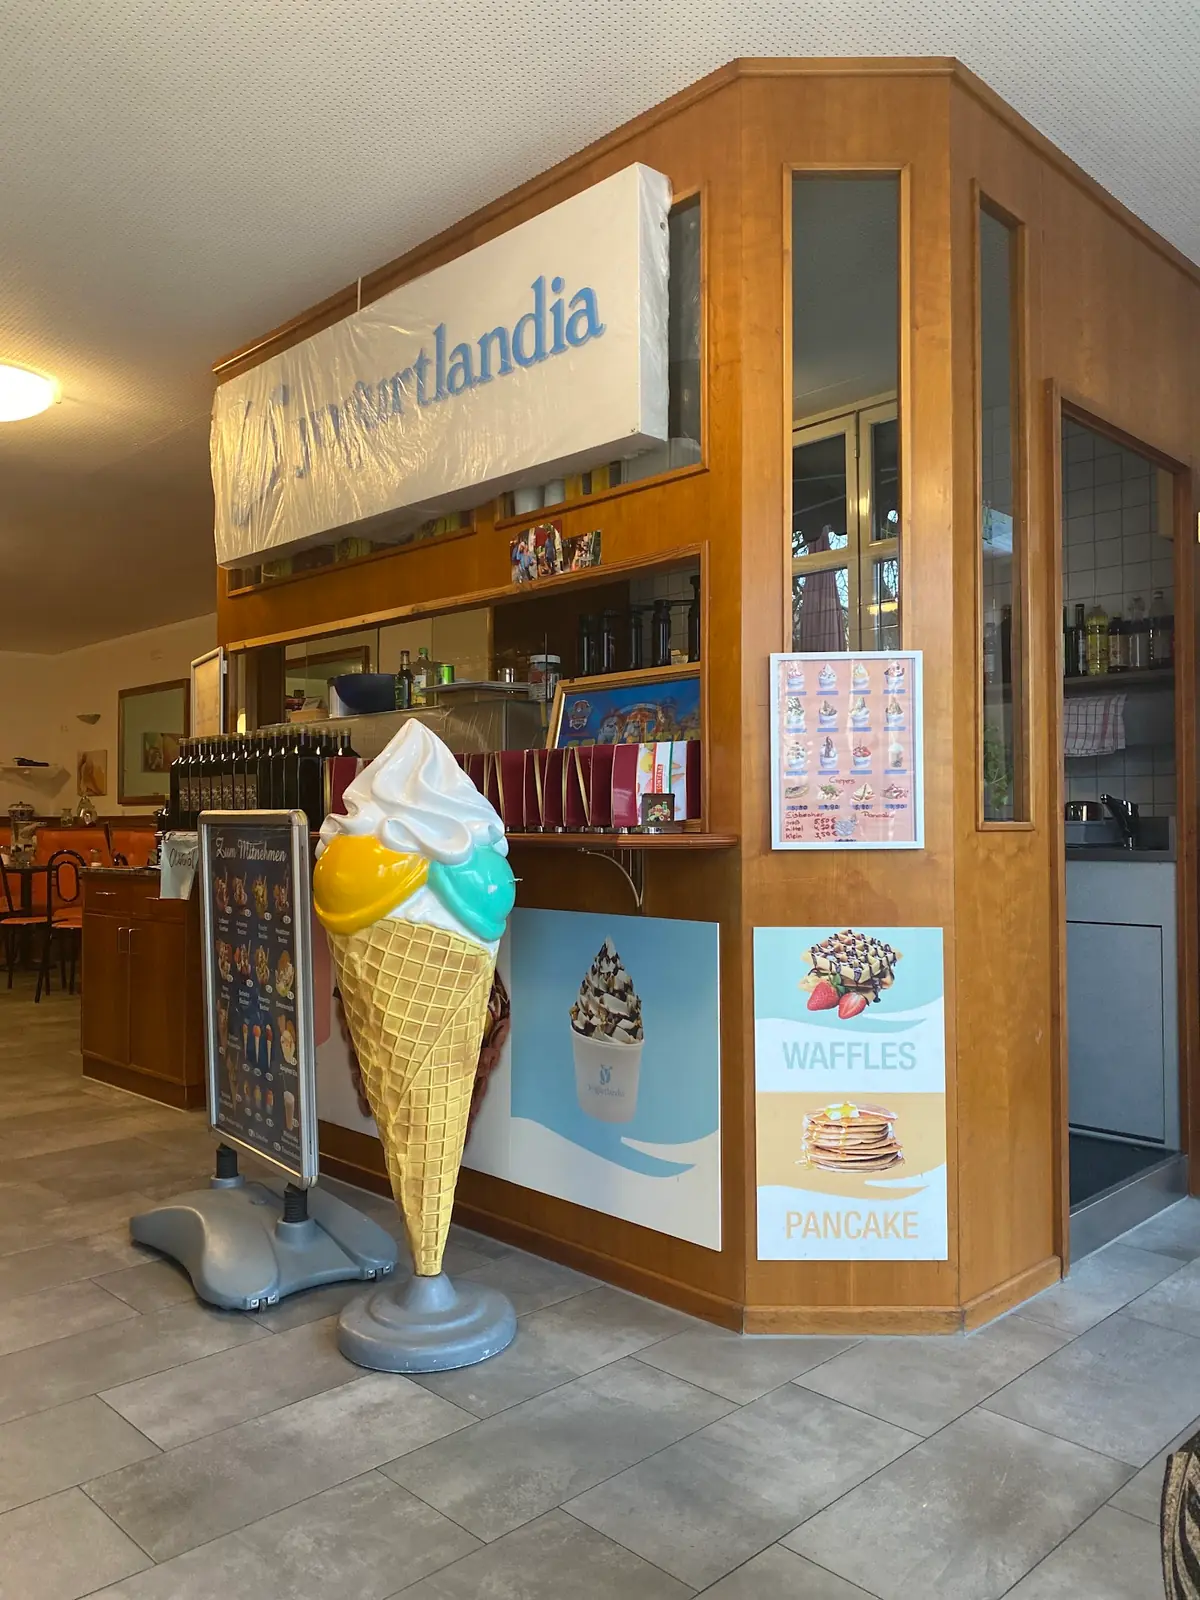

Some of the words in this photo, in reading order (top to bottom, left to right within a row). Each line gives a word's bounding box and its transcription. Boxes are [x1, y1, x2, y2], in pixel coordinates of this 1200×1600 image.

[215, 837, 236, 859] Zum
[238, 839, 287, 862] Mitnehmen
[782, 1041, 917, 1070] WAFFLES
[785, 1210, 919, 1239] PANCAKE
